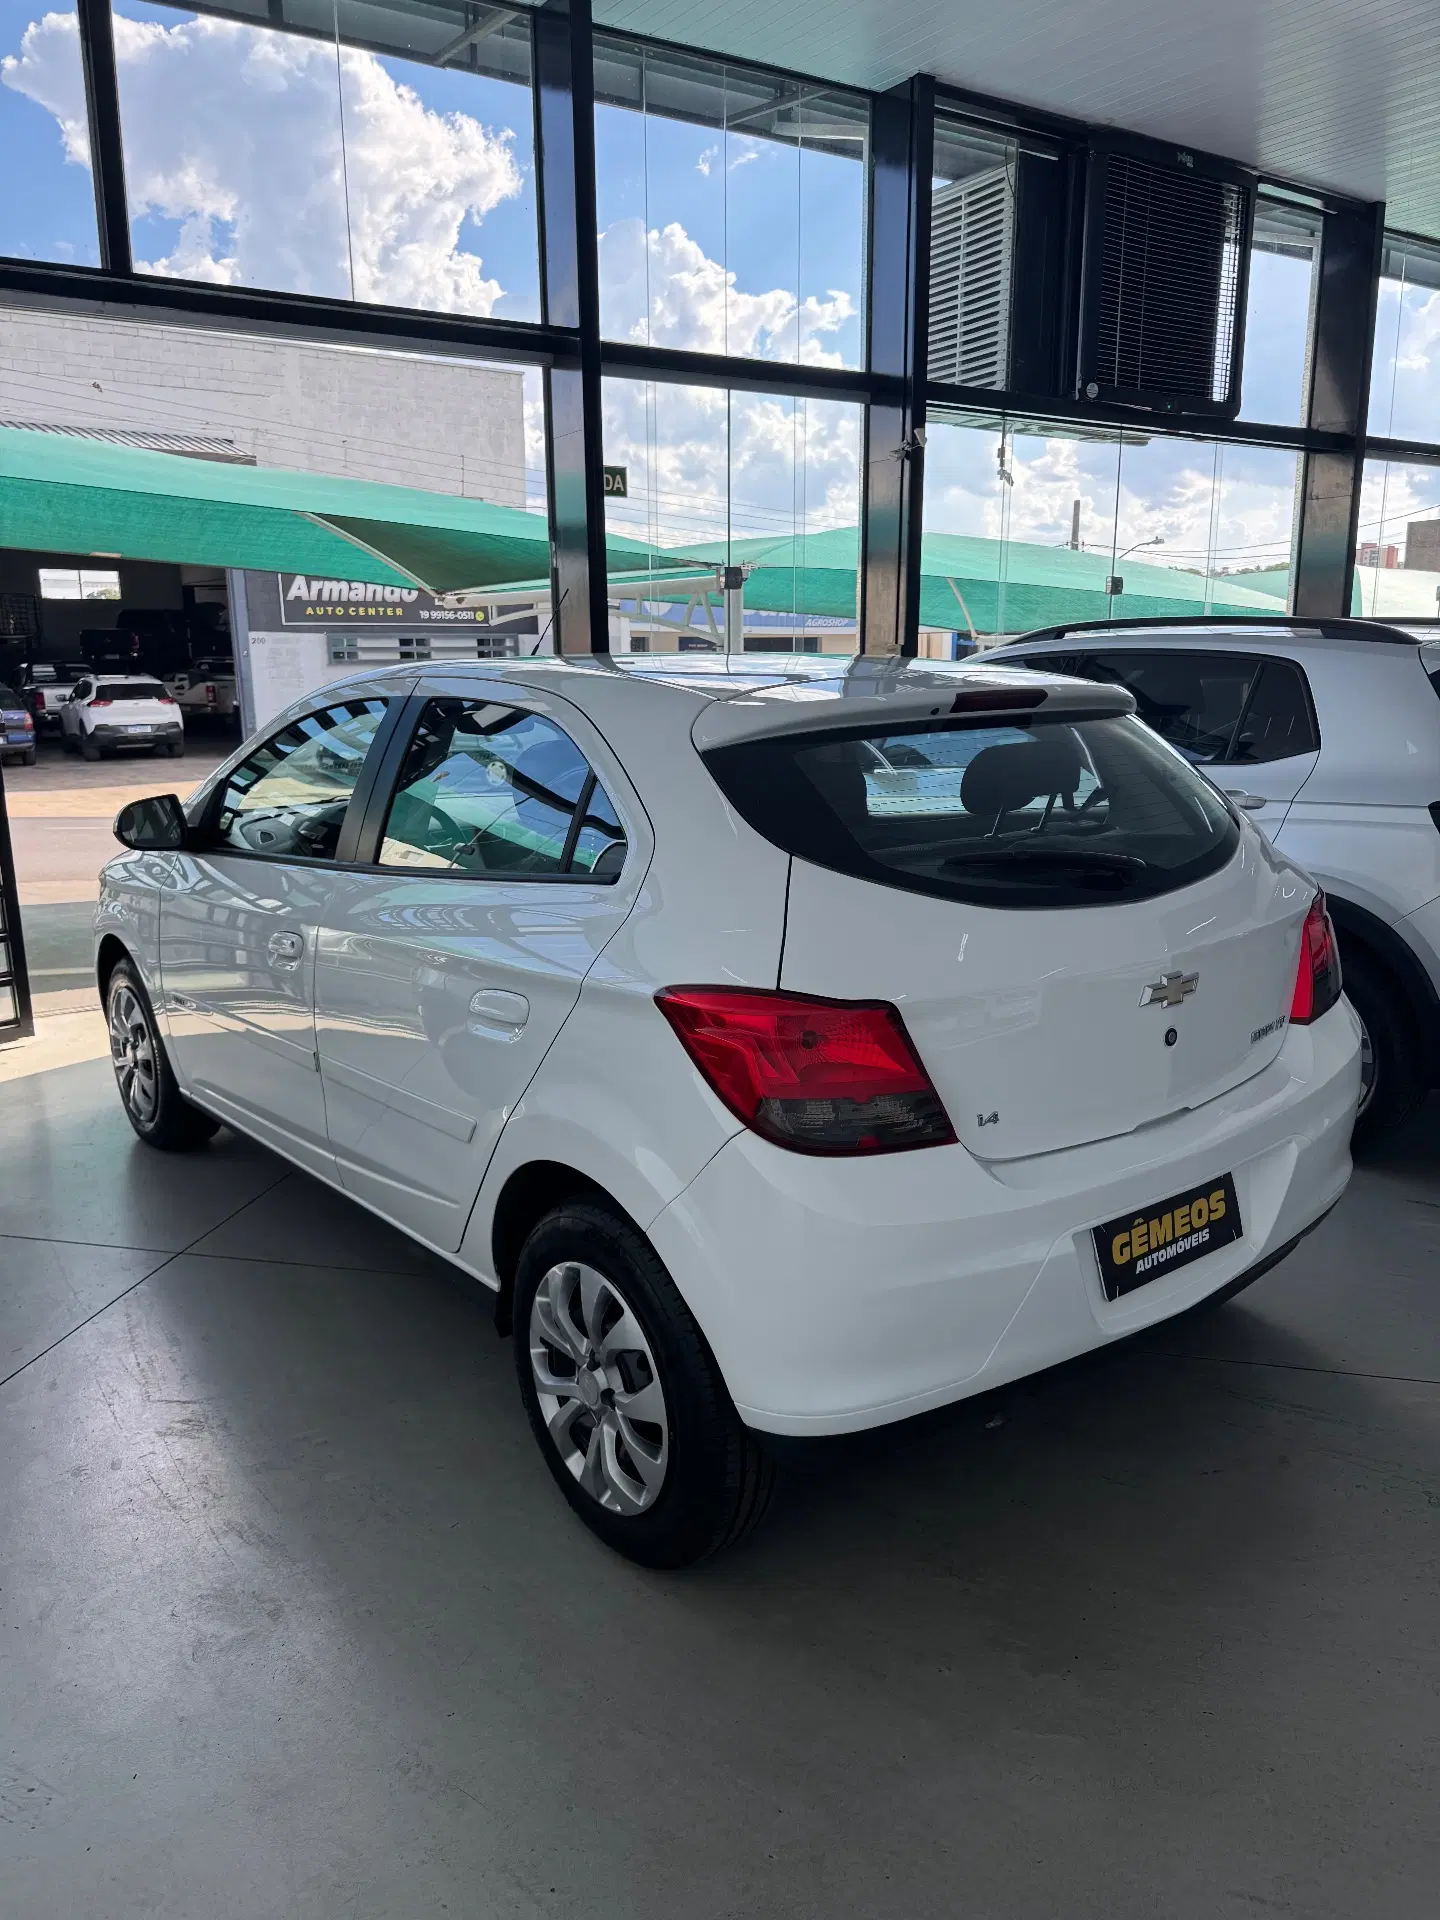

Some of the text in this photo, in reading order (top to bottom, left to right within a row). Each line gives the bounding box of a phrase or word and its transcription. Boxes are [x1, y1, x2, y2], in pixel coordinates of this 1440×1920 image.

[305, 606, 404, 617] AUTO CENTER
[419, 610, 430, 620] 19
[805, 618, 849, 628] AGROSHOP
[1111, 1188, 1226, 1266] GÊMEOS
[1135, 1228, 1210, 1275] AUTOMÓVEIS
